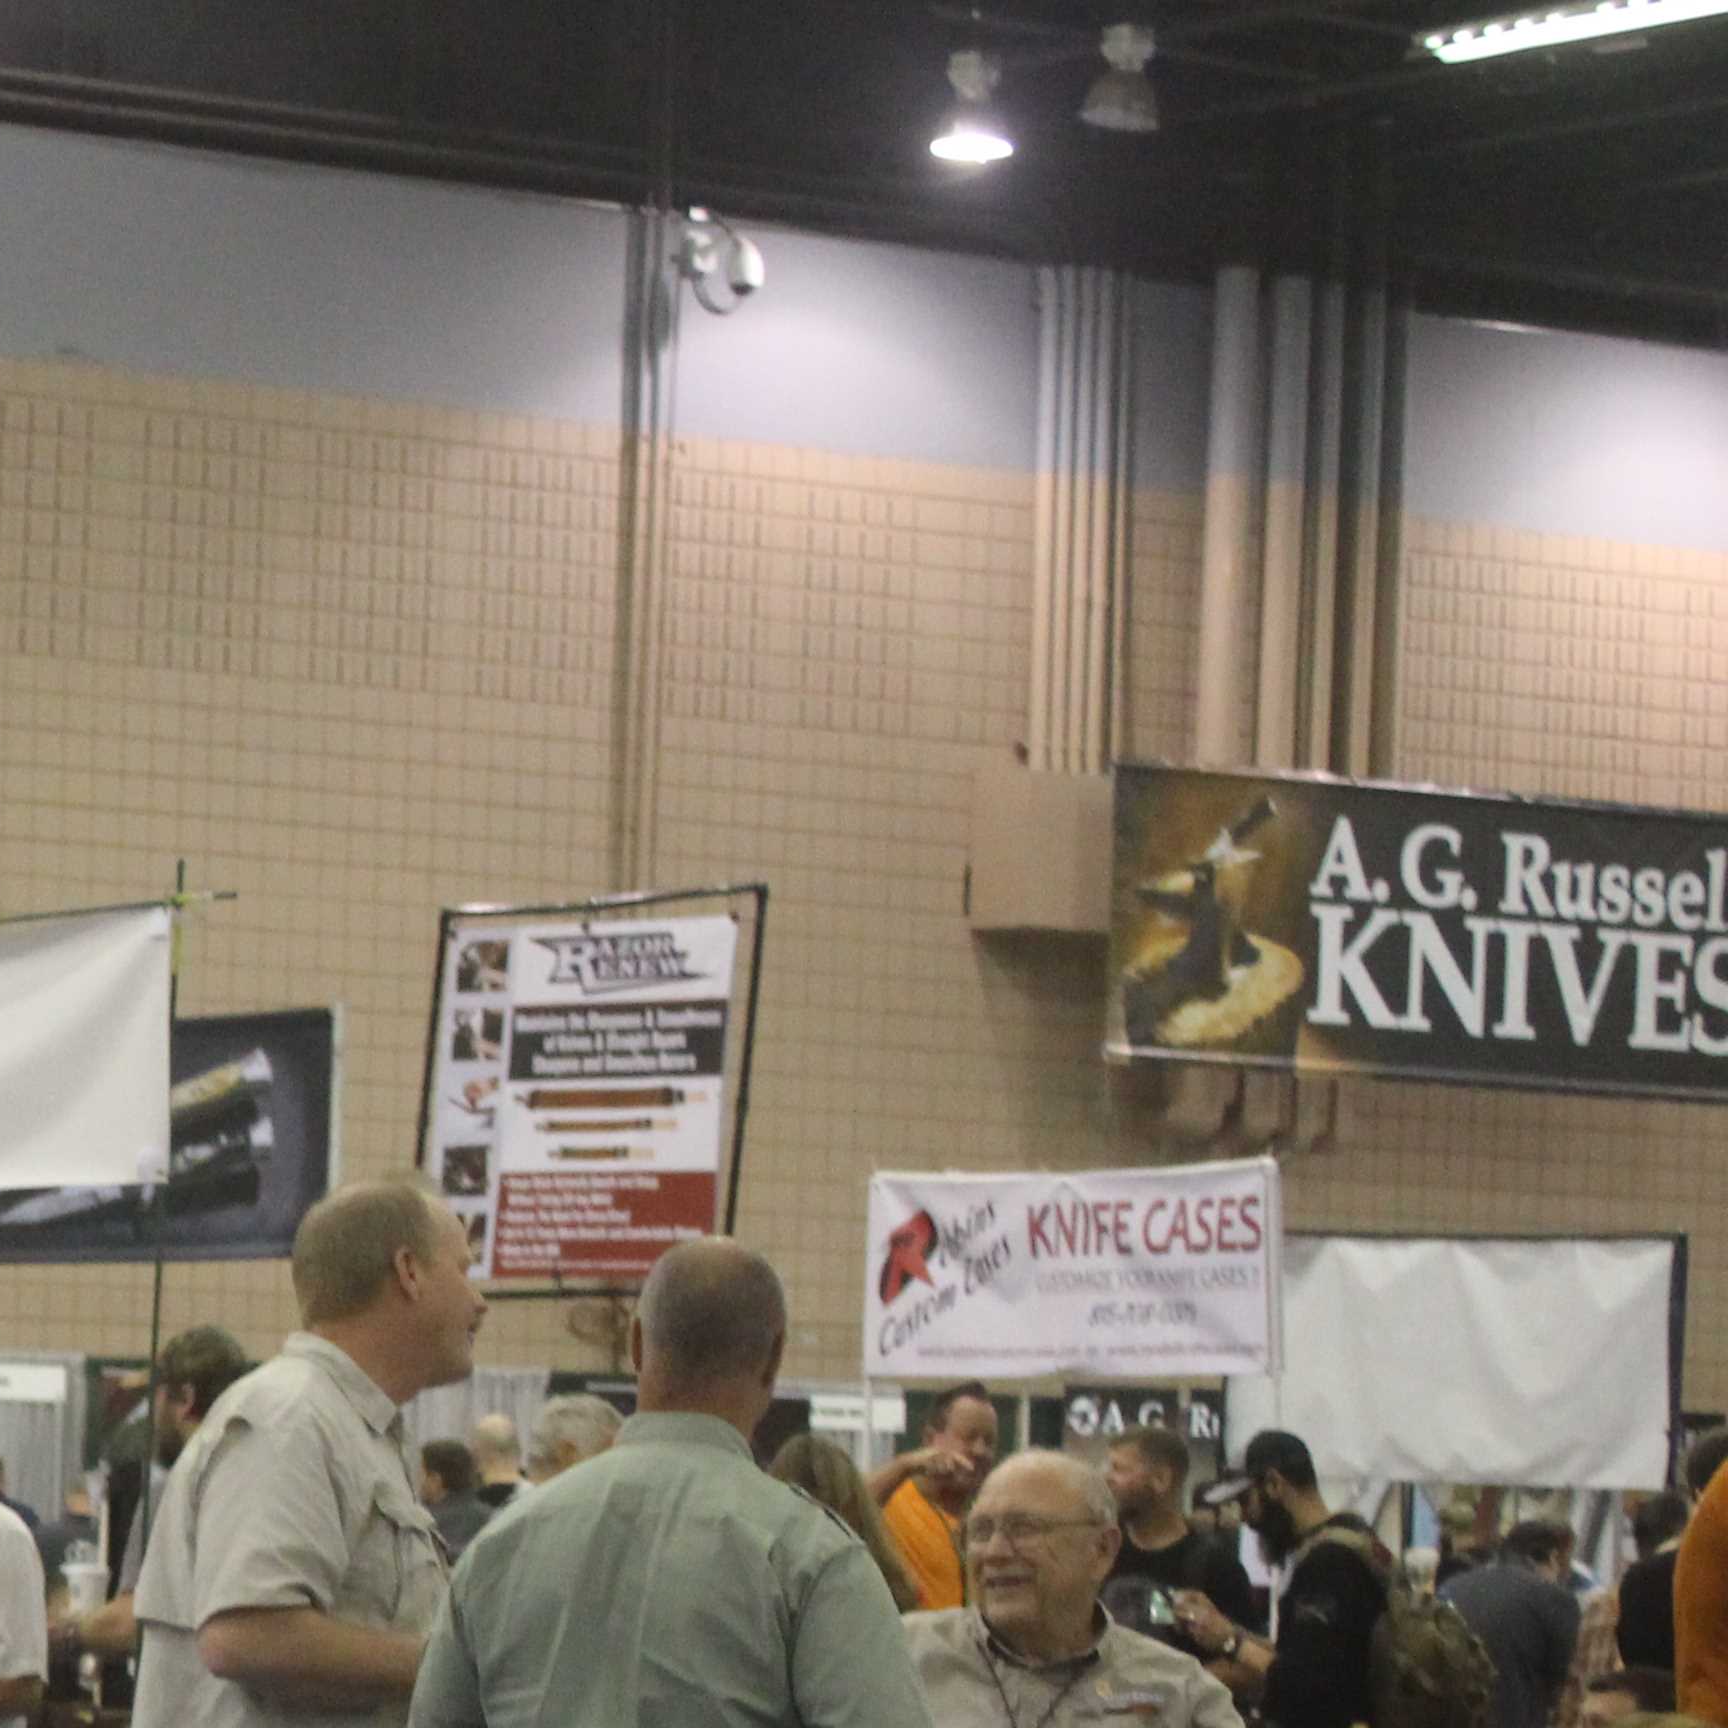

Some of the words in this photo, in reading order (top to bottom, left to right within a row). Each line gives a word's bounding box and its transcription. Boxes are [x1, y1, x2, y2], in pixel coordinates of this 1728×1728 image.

[1309, 815, 1391, 901] A.
[1401, 824, 1478, 911] G.
[1026, 1202, 1134, 1258] KNIFE
[1142, 1196, 1263, 1253] CASES
